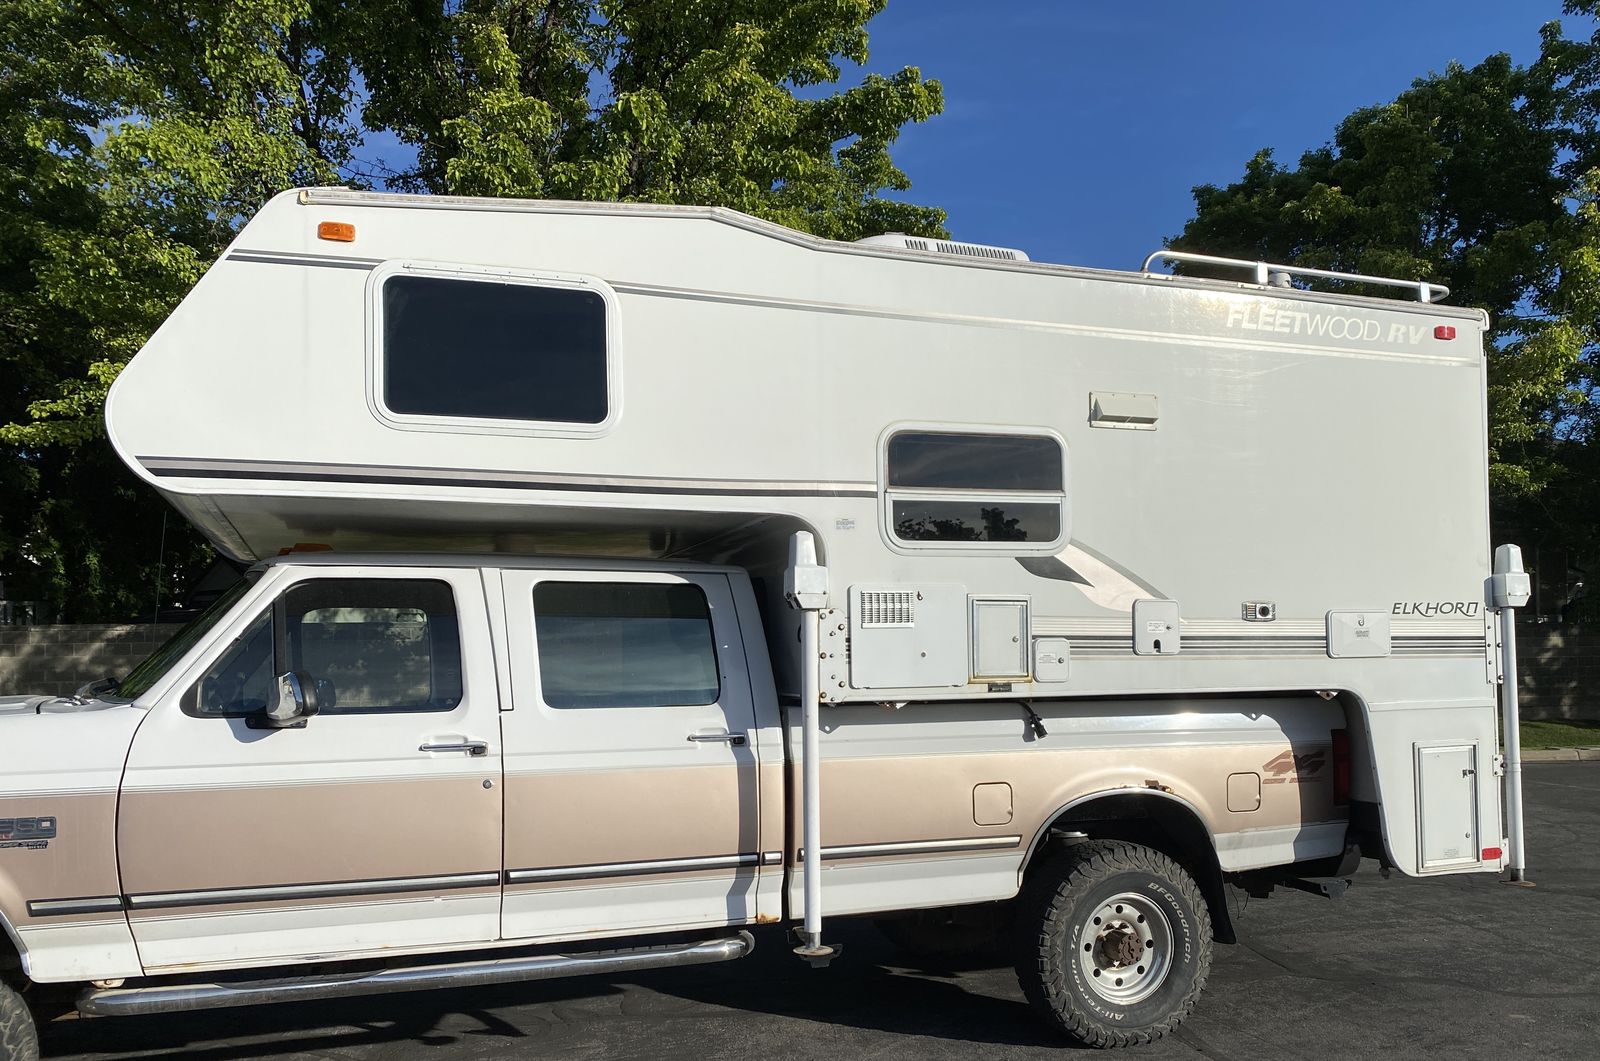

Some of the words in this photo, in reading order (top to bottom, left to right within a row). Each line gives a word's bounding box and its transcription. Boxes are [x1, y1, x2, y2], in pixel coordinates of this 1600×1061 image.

[1227, 304, 1380, 341] FLEETWOOD
[1387, 323, 1428, 344] RV
[1392, 602, 1478, 617] ELKHORN
[1070, 925, 1079, 950] T/A
[1148, 882, 1192, 964] BFGoodrich
[1071, 959, 1124, 1020] All-Terrain
